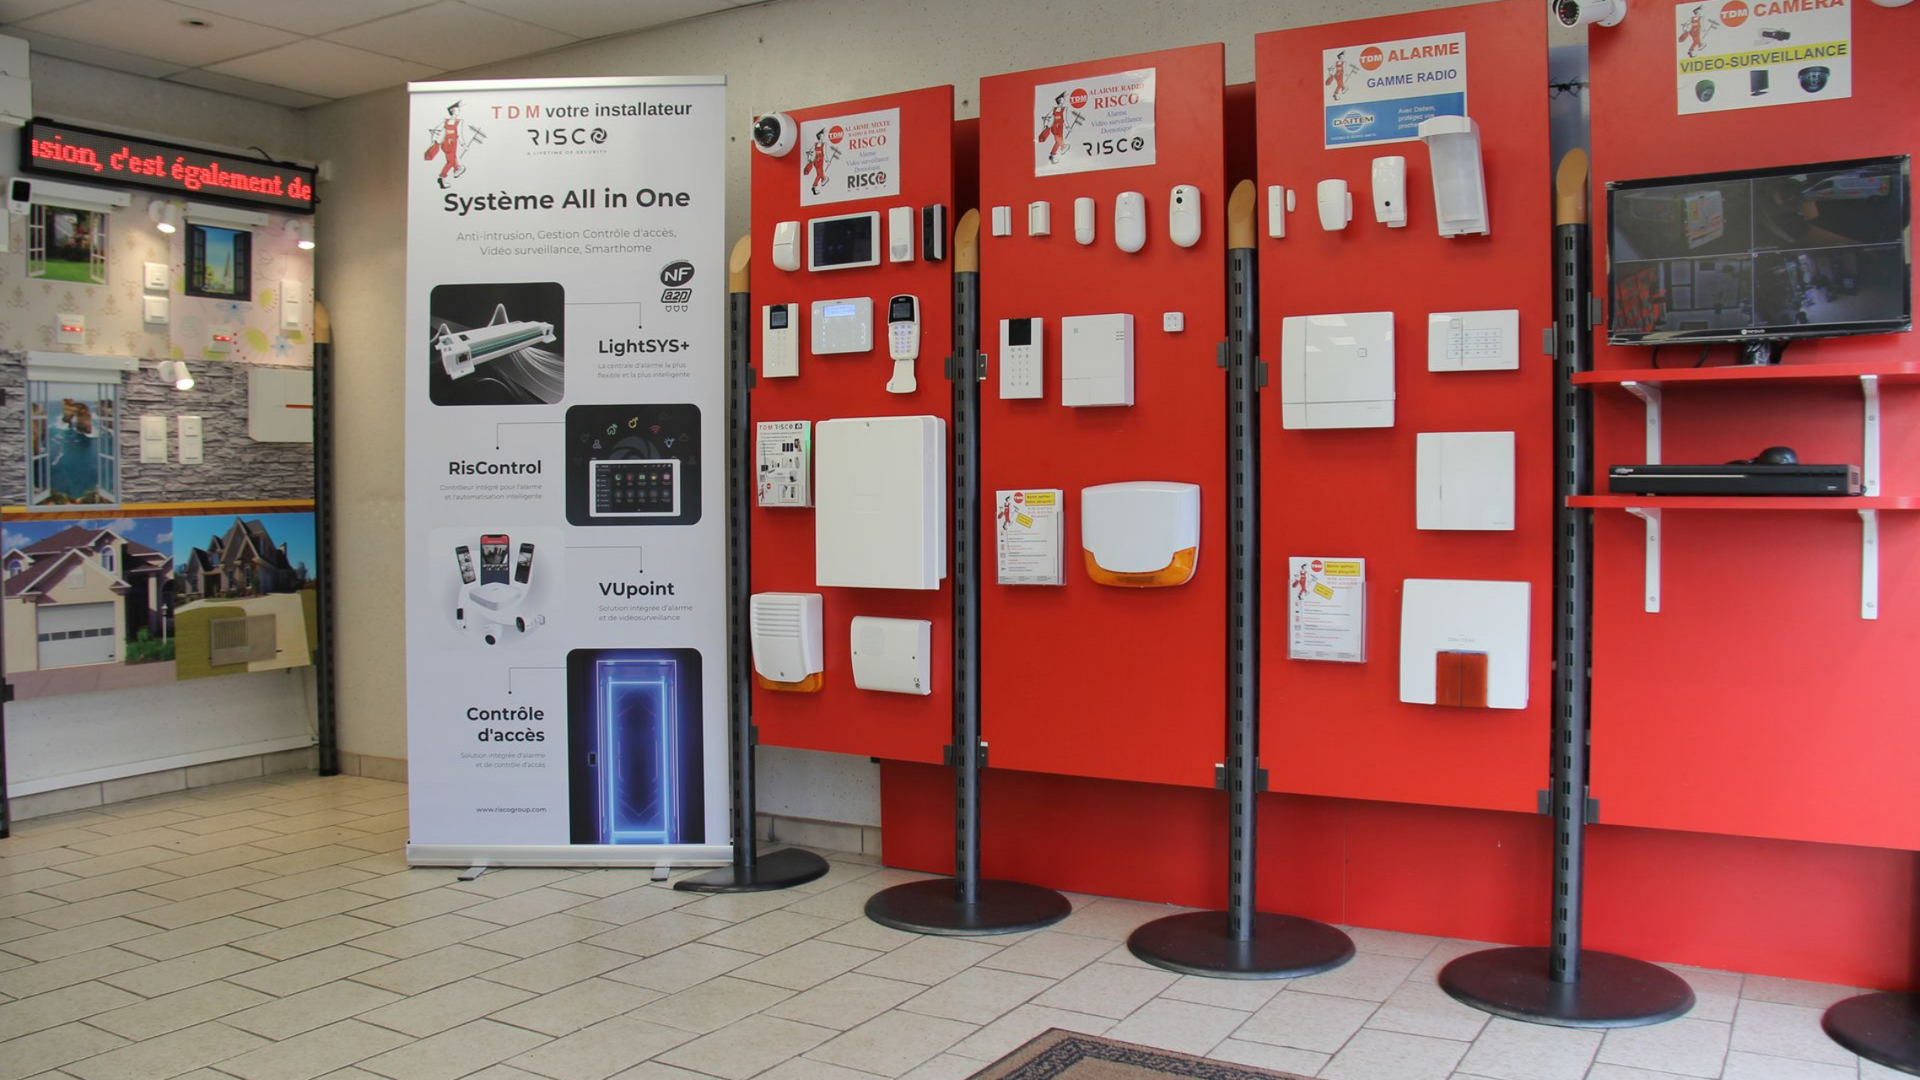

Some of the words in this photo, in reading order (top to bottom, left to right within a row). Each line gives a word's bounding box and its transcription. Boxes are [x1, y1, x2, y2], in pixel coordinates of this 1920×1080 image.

[1721, 8, 1748, 19] TDM
[1361, 54, 1383, 63] TDM
[1388, 42, 1460, 62] ALARME
[1680, 43, 1847, 73] VIDEO-SURVEILLANCE
[1367, 73, 1413, 88] GAMME
[1417, 69, 1457, 82] RADIO
[1070, 95, 1087, 104] TDM
[1090, 86, 1118, 95] ALARME
[1120, 83, 1144, 91] RADIO
[1094, 93, 1139, 109] RISCO
[545, 104, 590, 117] votre
[595, 101, 693, 116] installateur
[1333, 116, 1374, 126] DAITEM
[527, 128, 607, 146] RISCO
[849, 135, 886, 150] RISCO
[1082, 136, 1144, 156] RISCO
[110, 147, 167, 178] c'est
[171, 156, 284, 197] également
[287, 176, 312, 201] de
[847, 171, 887, 188] RISCO
[443, 190, 554, 216] Système
[562, 188, 595, 209] All
[604, 187, 627, 207] in
[636, 187, 690, 208] One
[456, 229, 536, 242] Anti-intrusion,
[537, 228, 580, 240] Gestion
[582, 227, 631, 240] Contrôle
[633, 227, 677, 240] d'accès,
[480, 244, 512, 256] Vidéo
[514, 243, 583, 256] surveillance,
[584, 242, 652, 254] Smarthome
[664, 267, 692, 281] NF
[599, 338, 690, 357] LightSYS+
[448, 459, 542, 475] RisControl
[599, 580, 675, 599] VUpoint
[466, 706, 544, 721] Contrôle
[477, 727, 545, 742] d'accès
[476, 806, 547, 814] www.riscogroup.com
